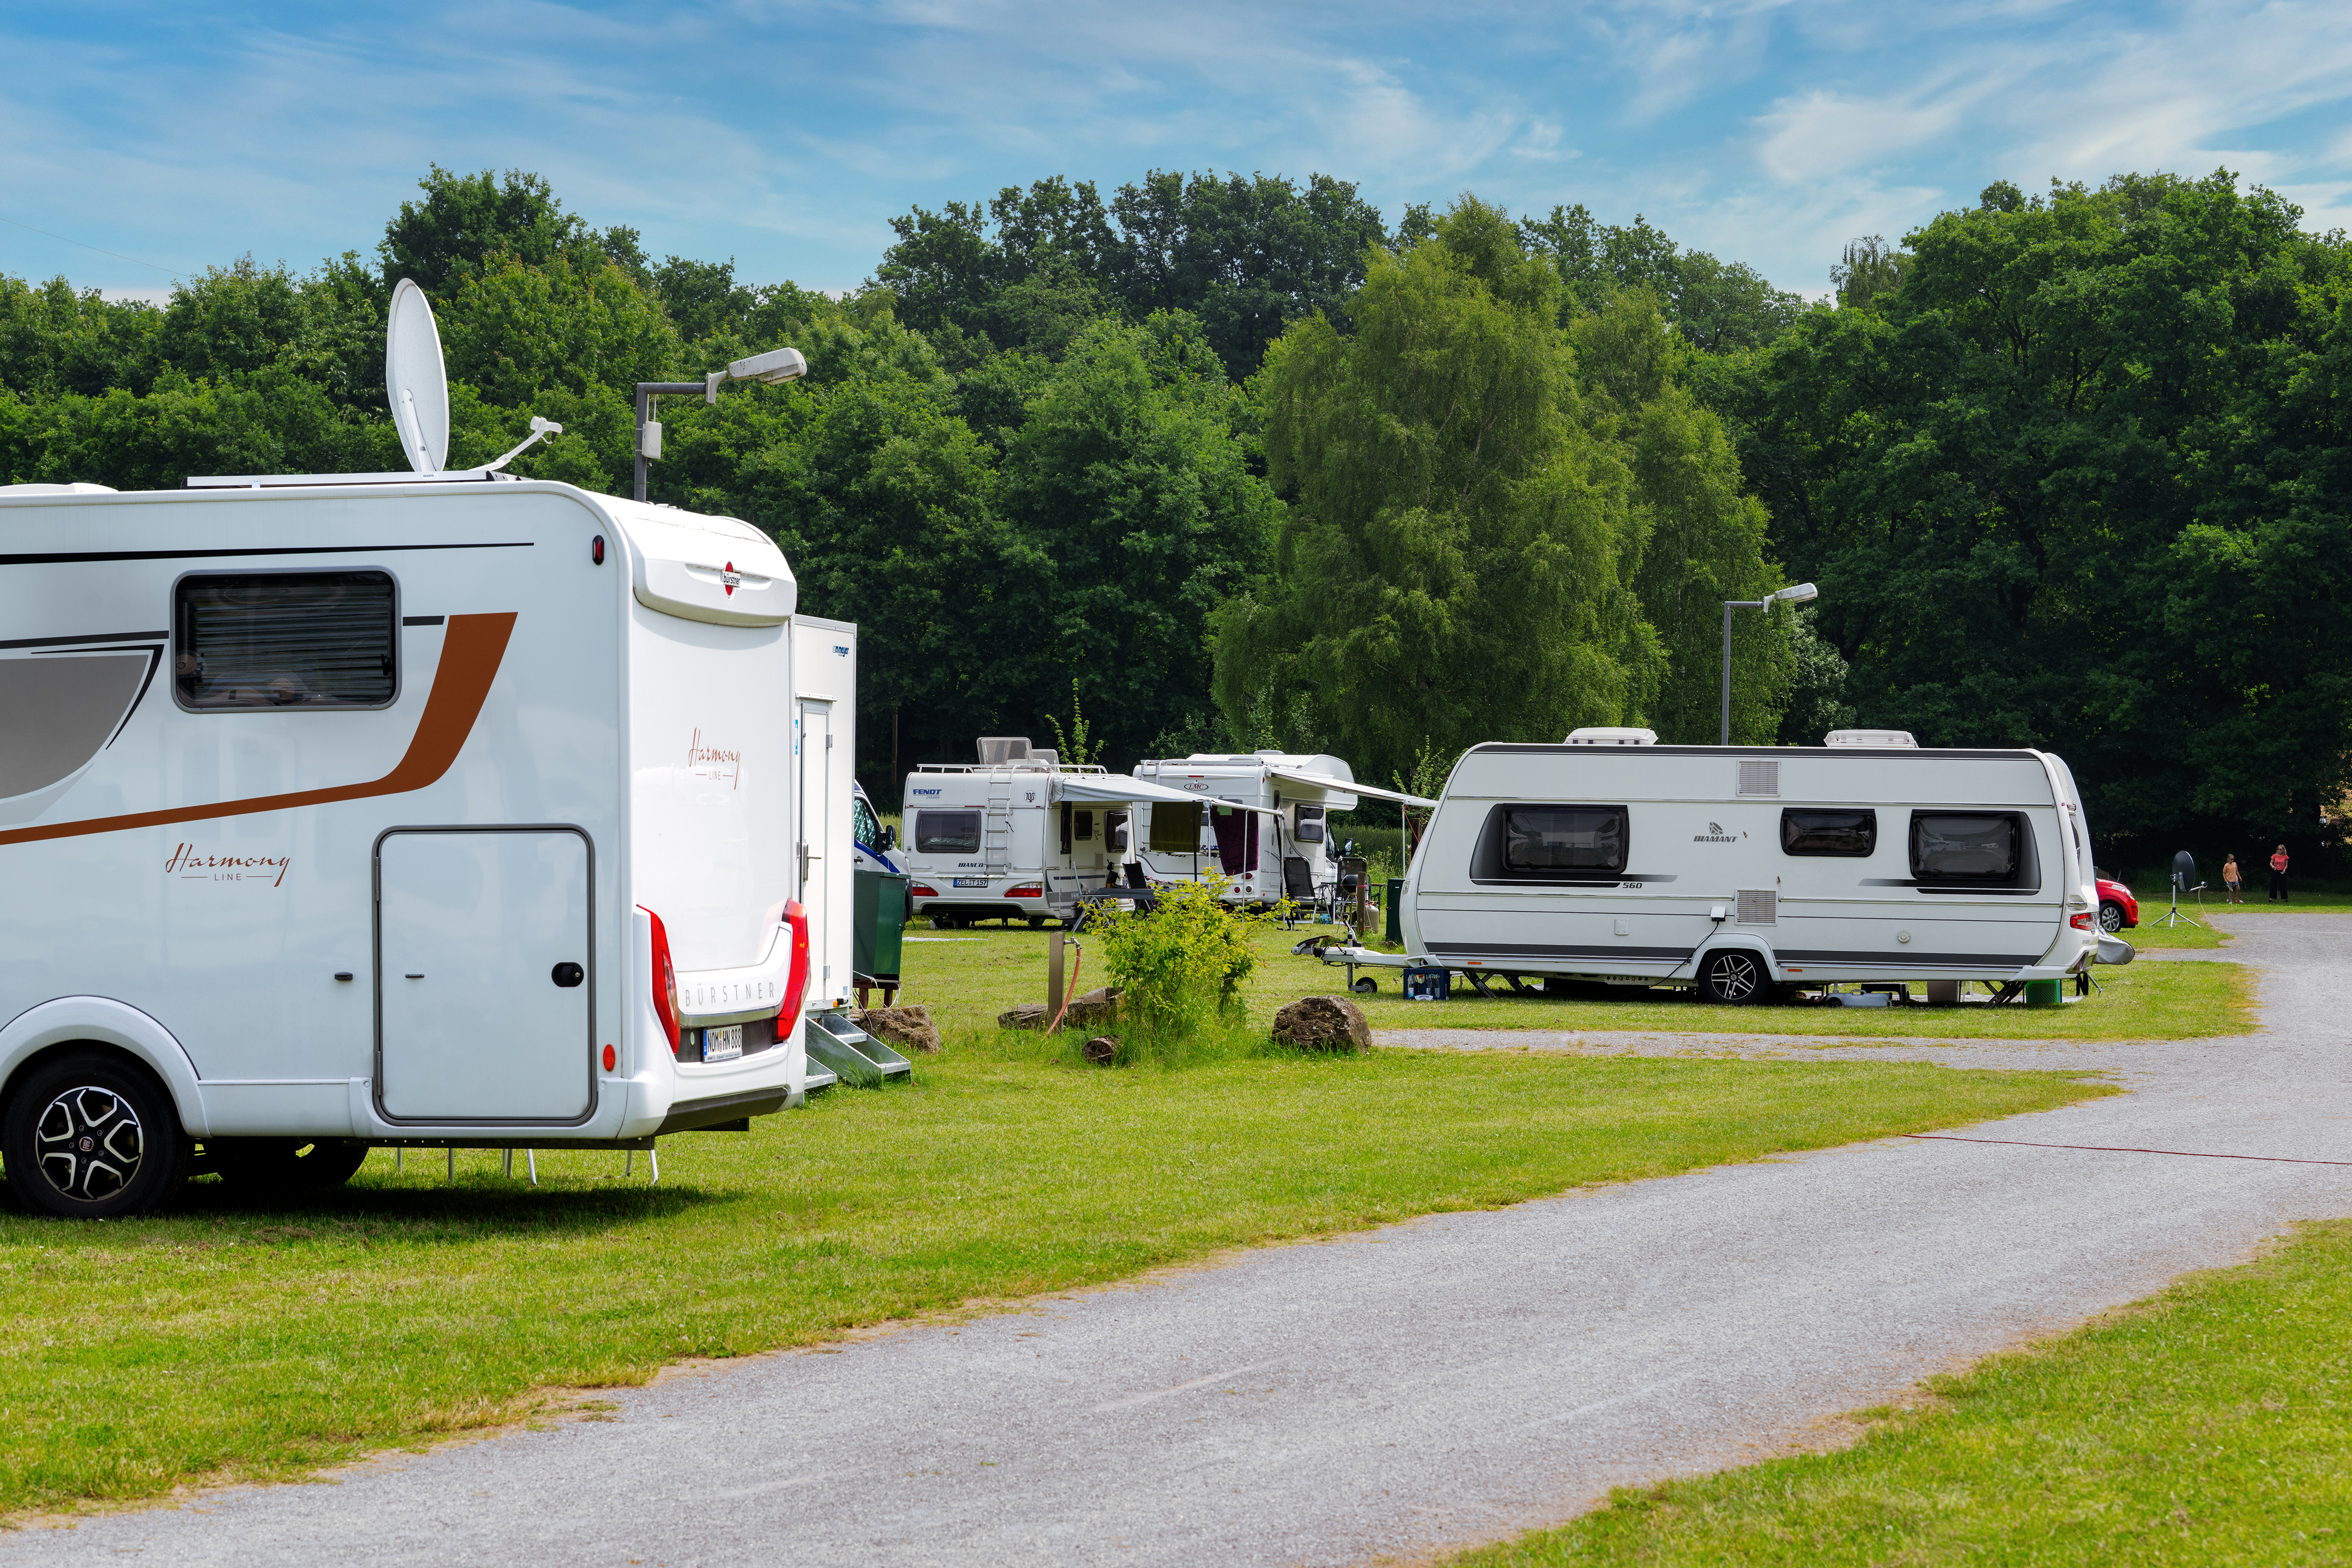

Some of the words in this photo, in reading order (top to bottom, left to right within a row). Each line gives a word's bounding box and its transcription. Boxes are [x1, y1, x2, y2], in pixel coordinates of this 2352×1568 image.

[723, 572, 740, 585] bürstner
[689, 727, 740, 790] Harmony
[709, 771, 720, 780] LINE
[165, 842, 290, 888] Harmony
[685, 982, 774, 1007] BÜRSTNER
[707, 1031, 719, 1053] NOM
[723, 1029, 730, 1050] HN
[731, 1027, 741, 1049] 888
